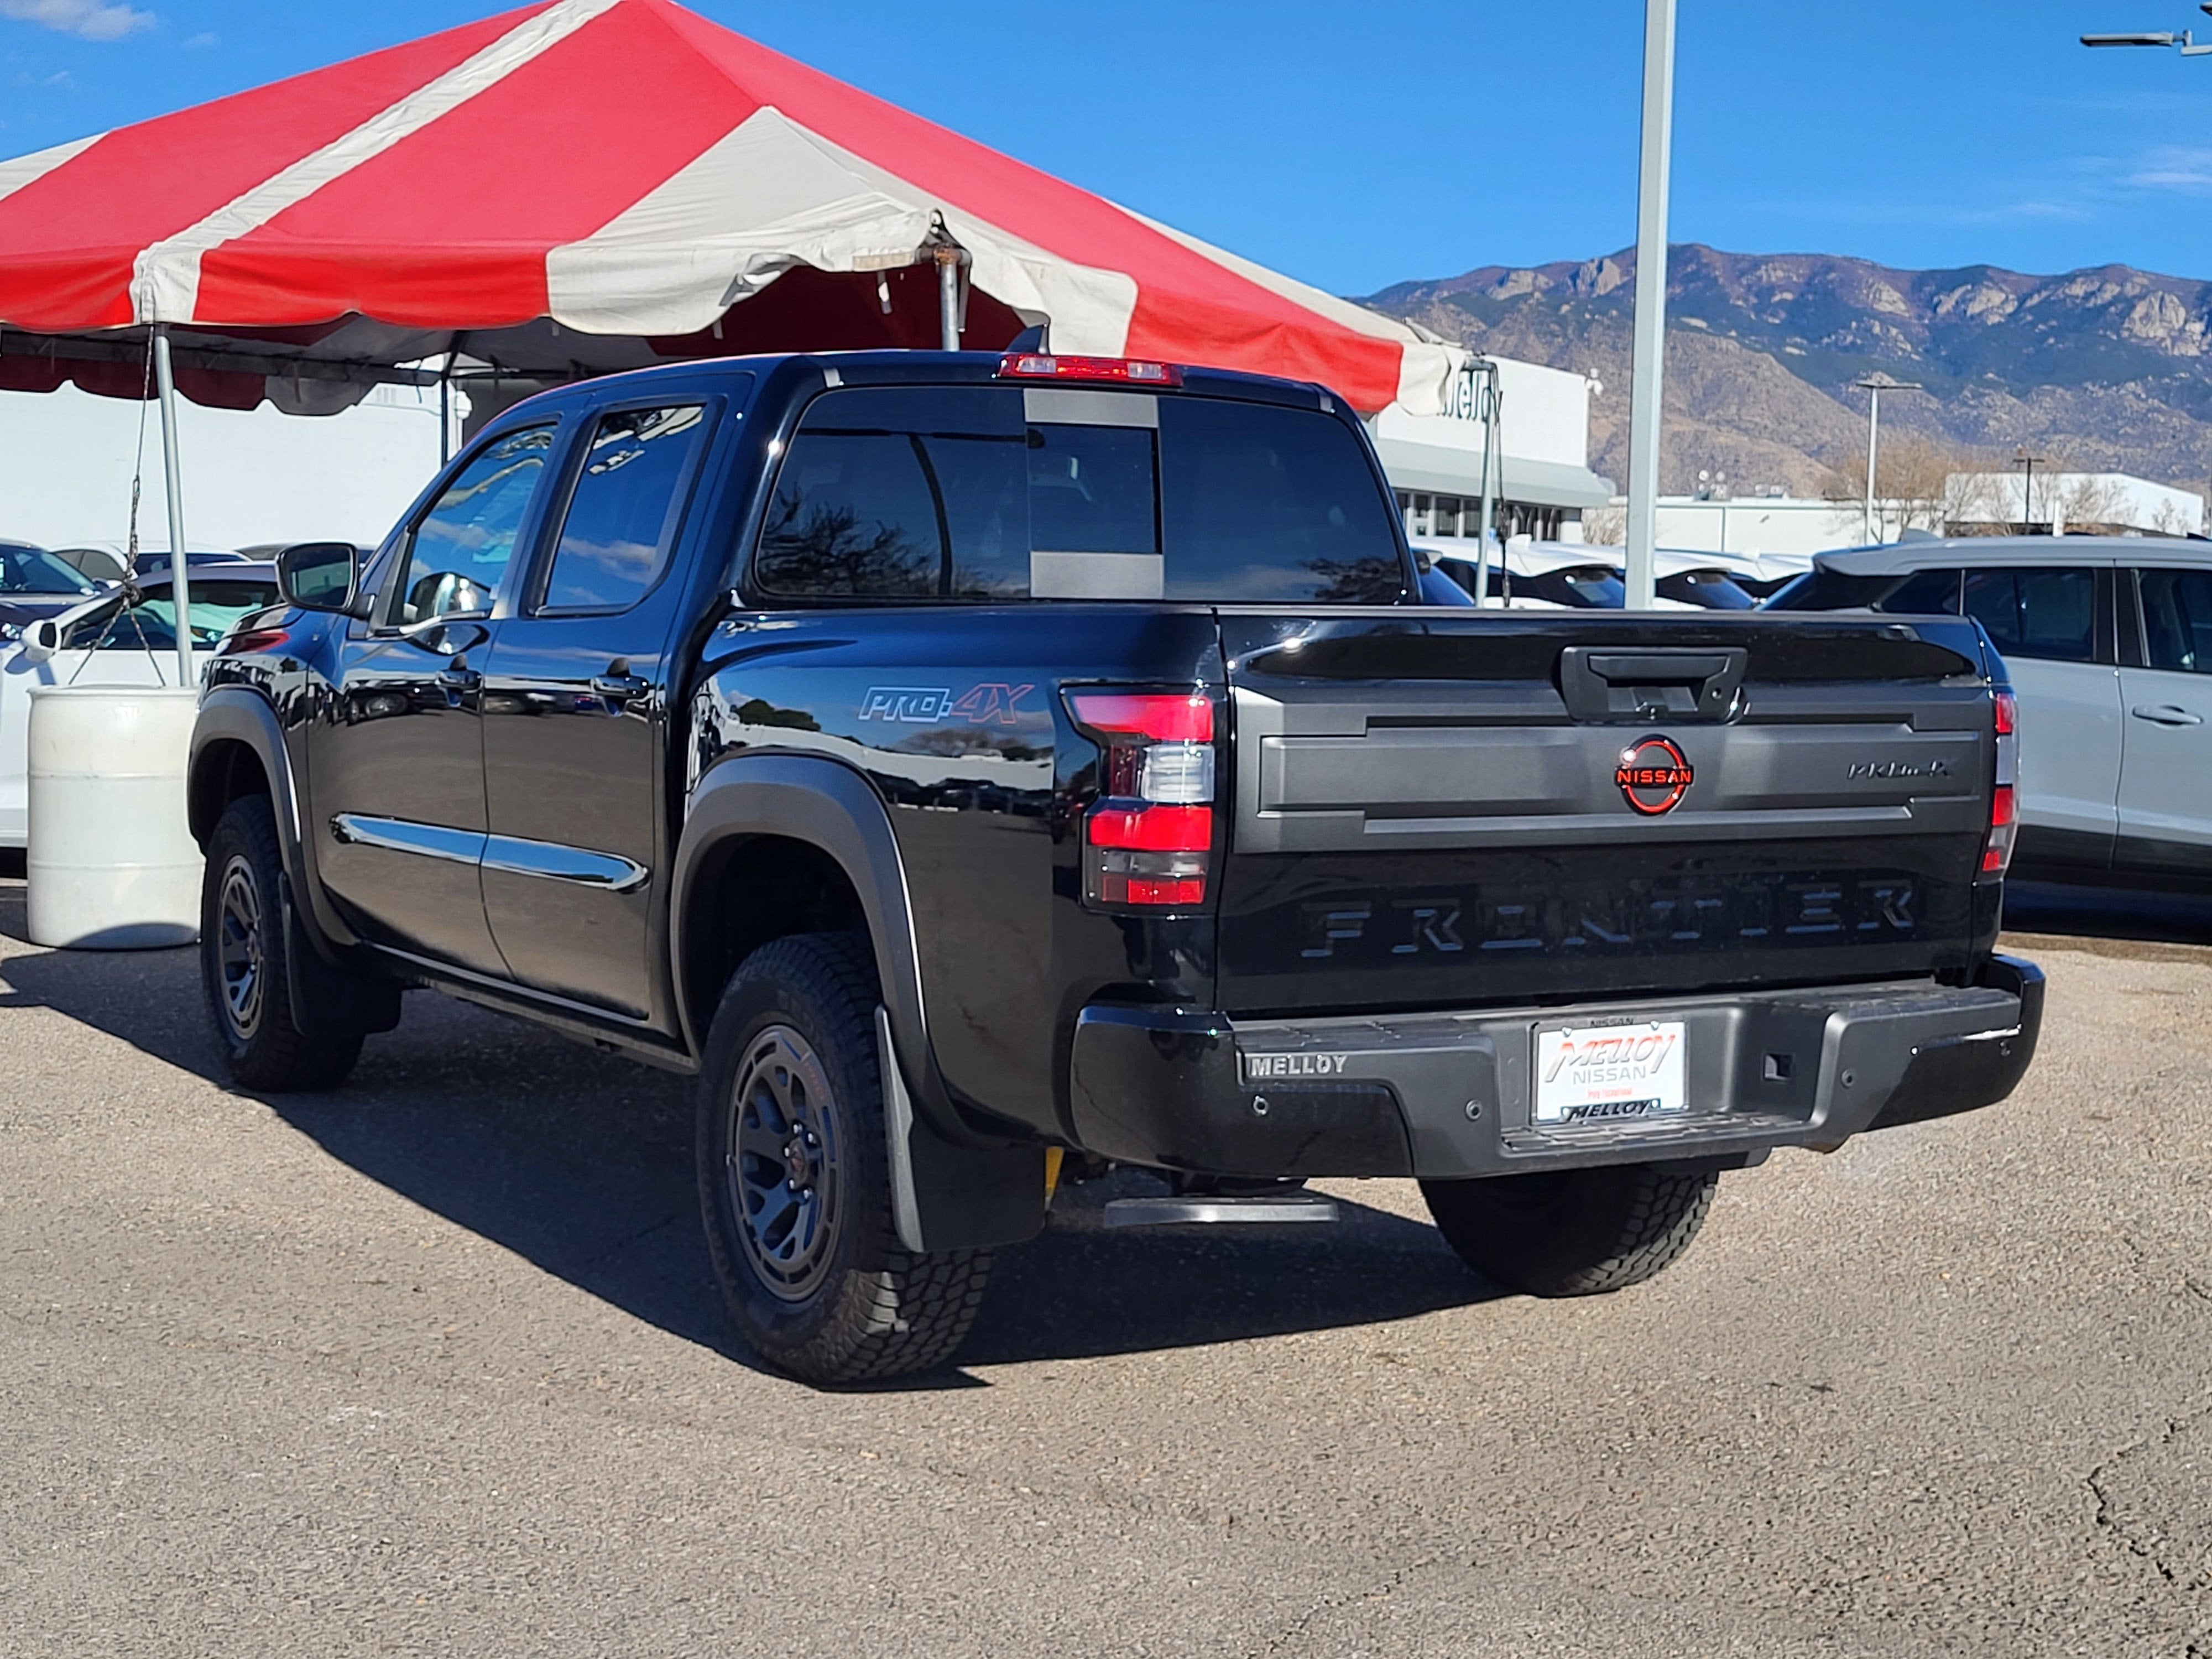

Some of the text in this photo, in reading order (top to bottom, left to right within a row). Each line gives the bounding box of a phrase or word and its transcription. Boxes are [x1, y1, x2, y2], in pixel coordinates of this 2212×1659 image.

[1616, 769, 1692, 784] NISSAN
[1301, 881, 1913, 958] FRONTIER
[1250, 1055, 1348, 1076] MELLOY
[1545, 1034, 1676, 1083] MELLOY
[1573, 1065, 1646, 1085] NISSAN
[1565, 1100, 1651, 1123] MELLOY
